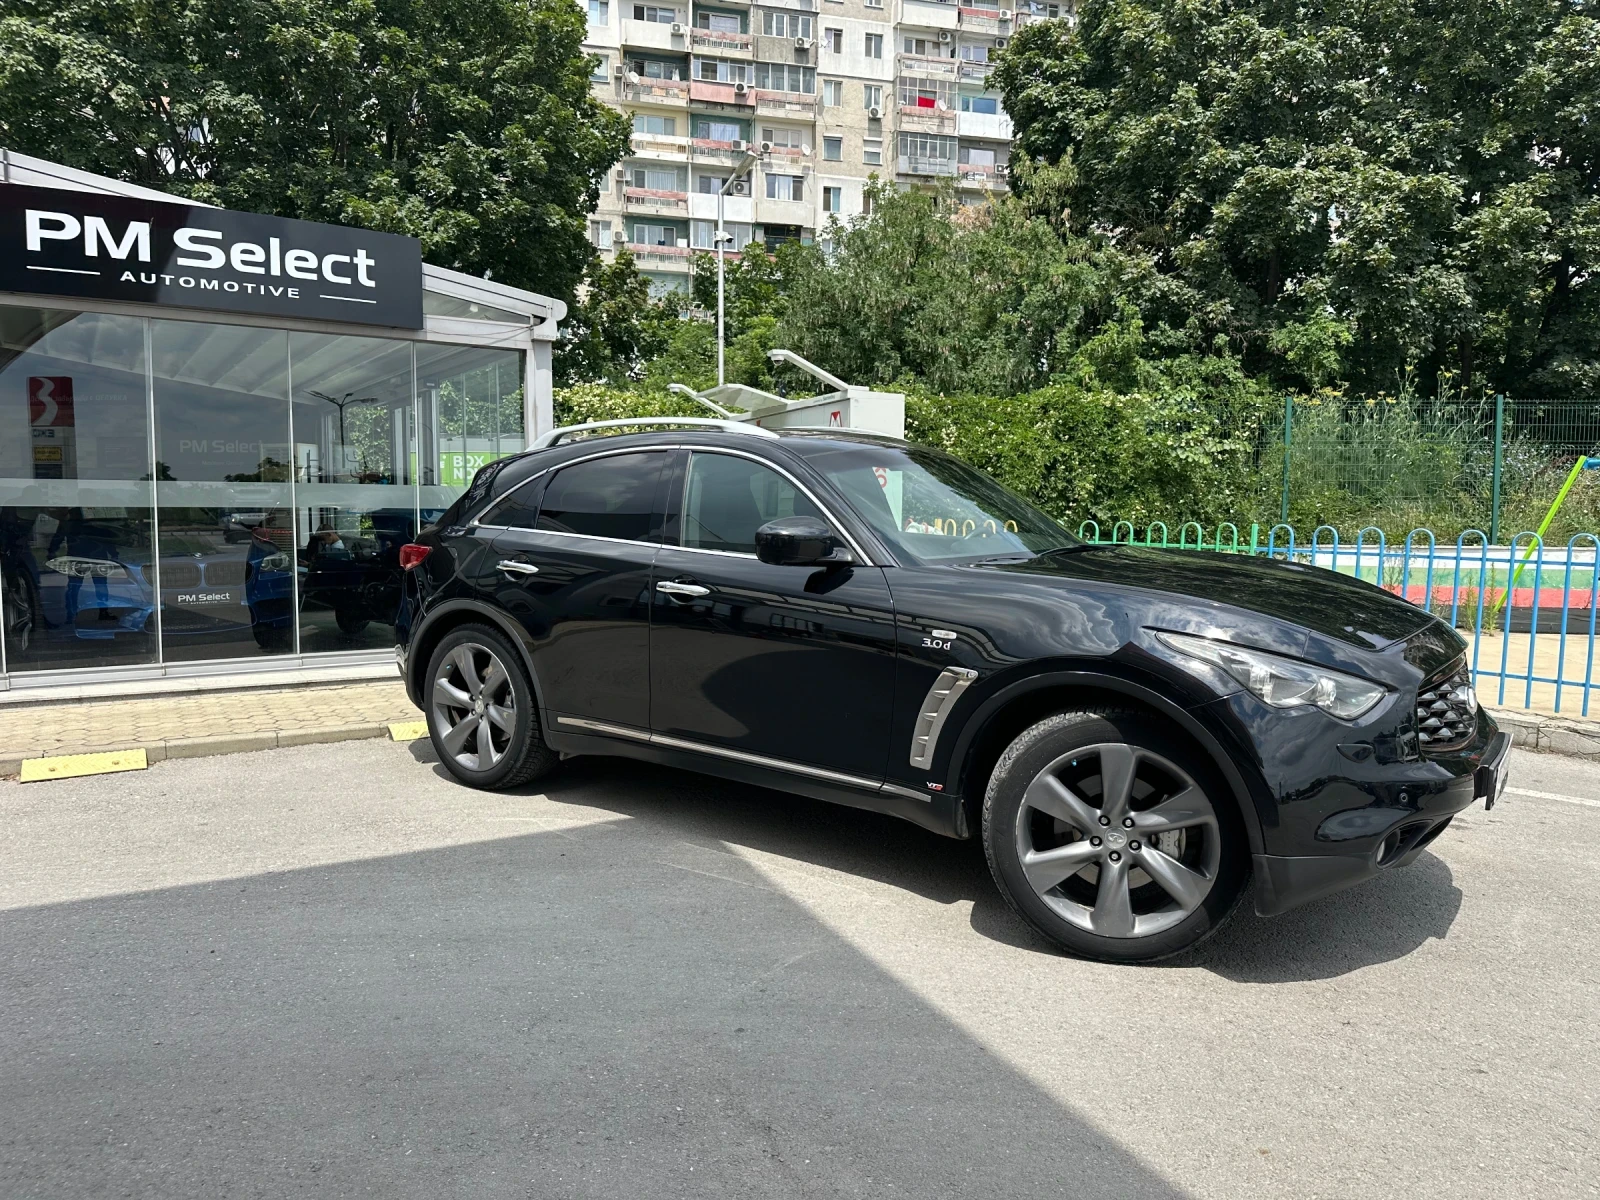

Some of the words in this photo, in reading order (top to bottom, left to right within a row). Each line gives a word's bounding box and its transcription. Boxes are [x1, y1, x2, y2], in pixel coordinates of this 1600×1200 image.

[25, 209, 151, 262] PM
[173, 227, 376, 288] Select
[120, 271, 300, 299] AUTOMOTIVE
[180, 440, 208, 453] PM
[211, 440, 263, 453] Select
[453, 455, 484, 467] BOX
[453, 468, 476, 480] NO
[198, 593, 230, 601] Select
